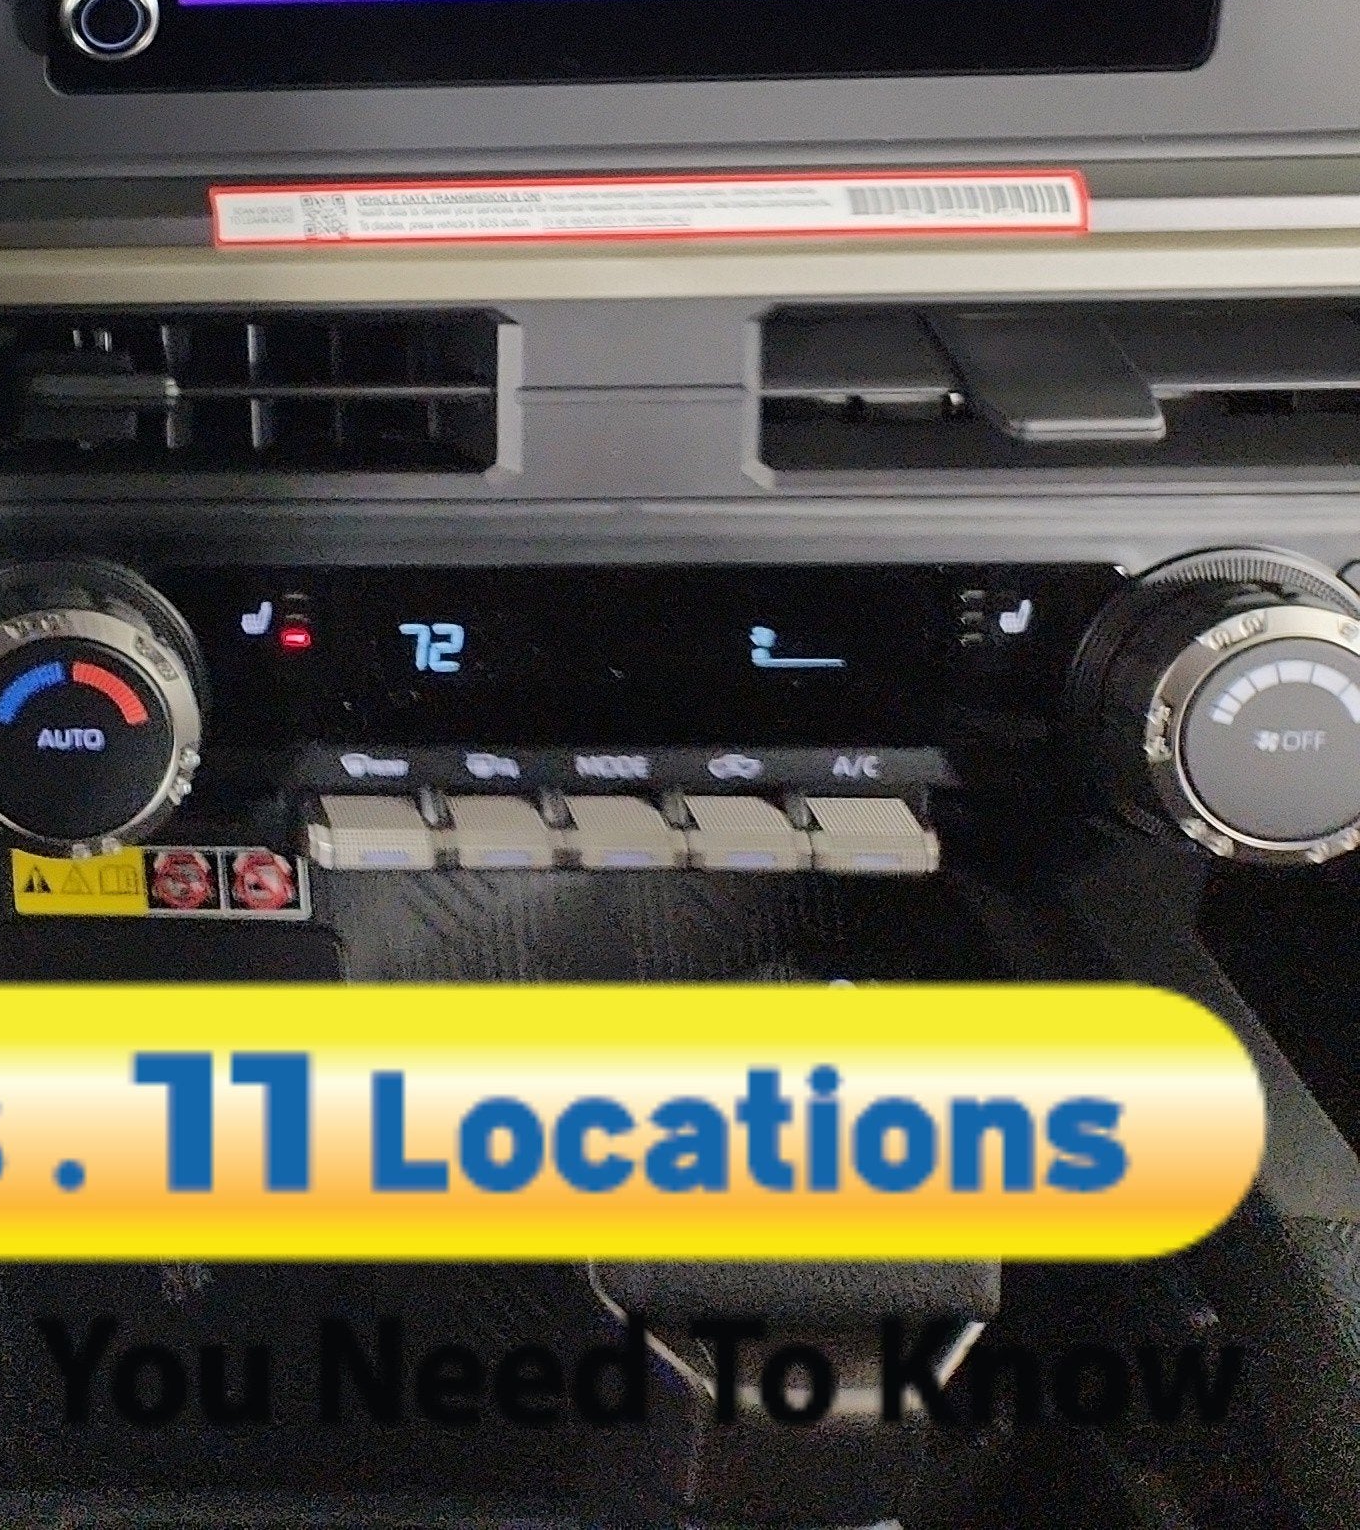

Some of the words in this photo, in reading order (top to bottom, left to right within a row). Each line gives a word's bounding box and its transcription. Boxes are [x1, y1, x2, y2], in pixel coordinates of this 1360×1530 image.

[398, 623, 465, 672] 72
[36, 727, 105, 752] AUTO
[1282, 730, 1327, 752] OFF
[575, 755, 651, 780] MODE
[833, 755, 880, 779] A/C
